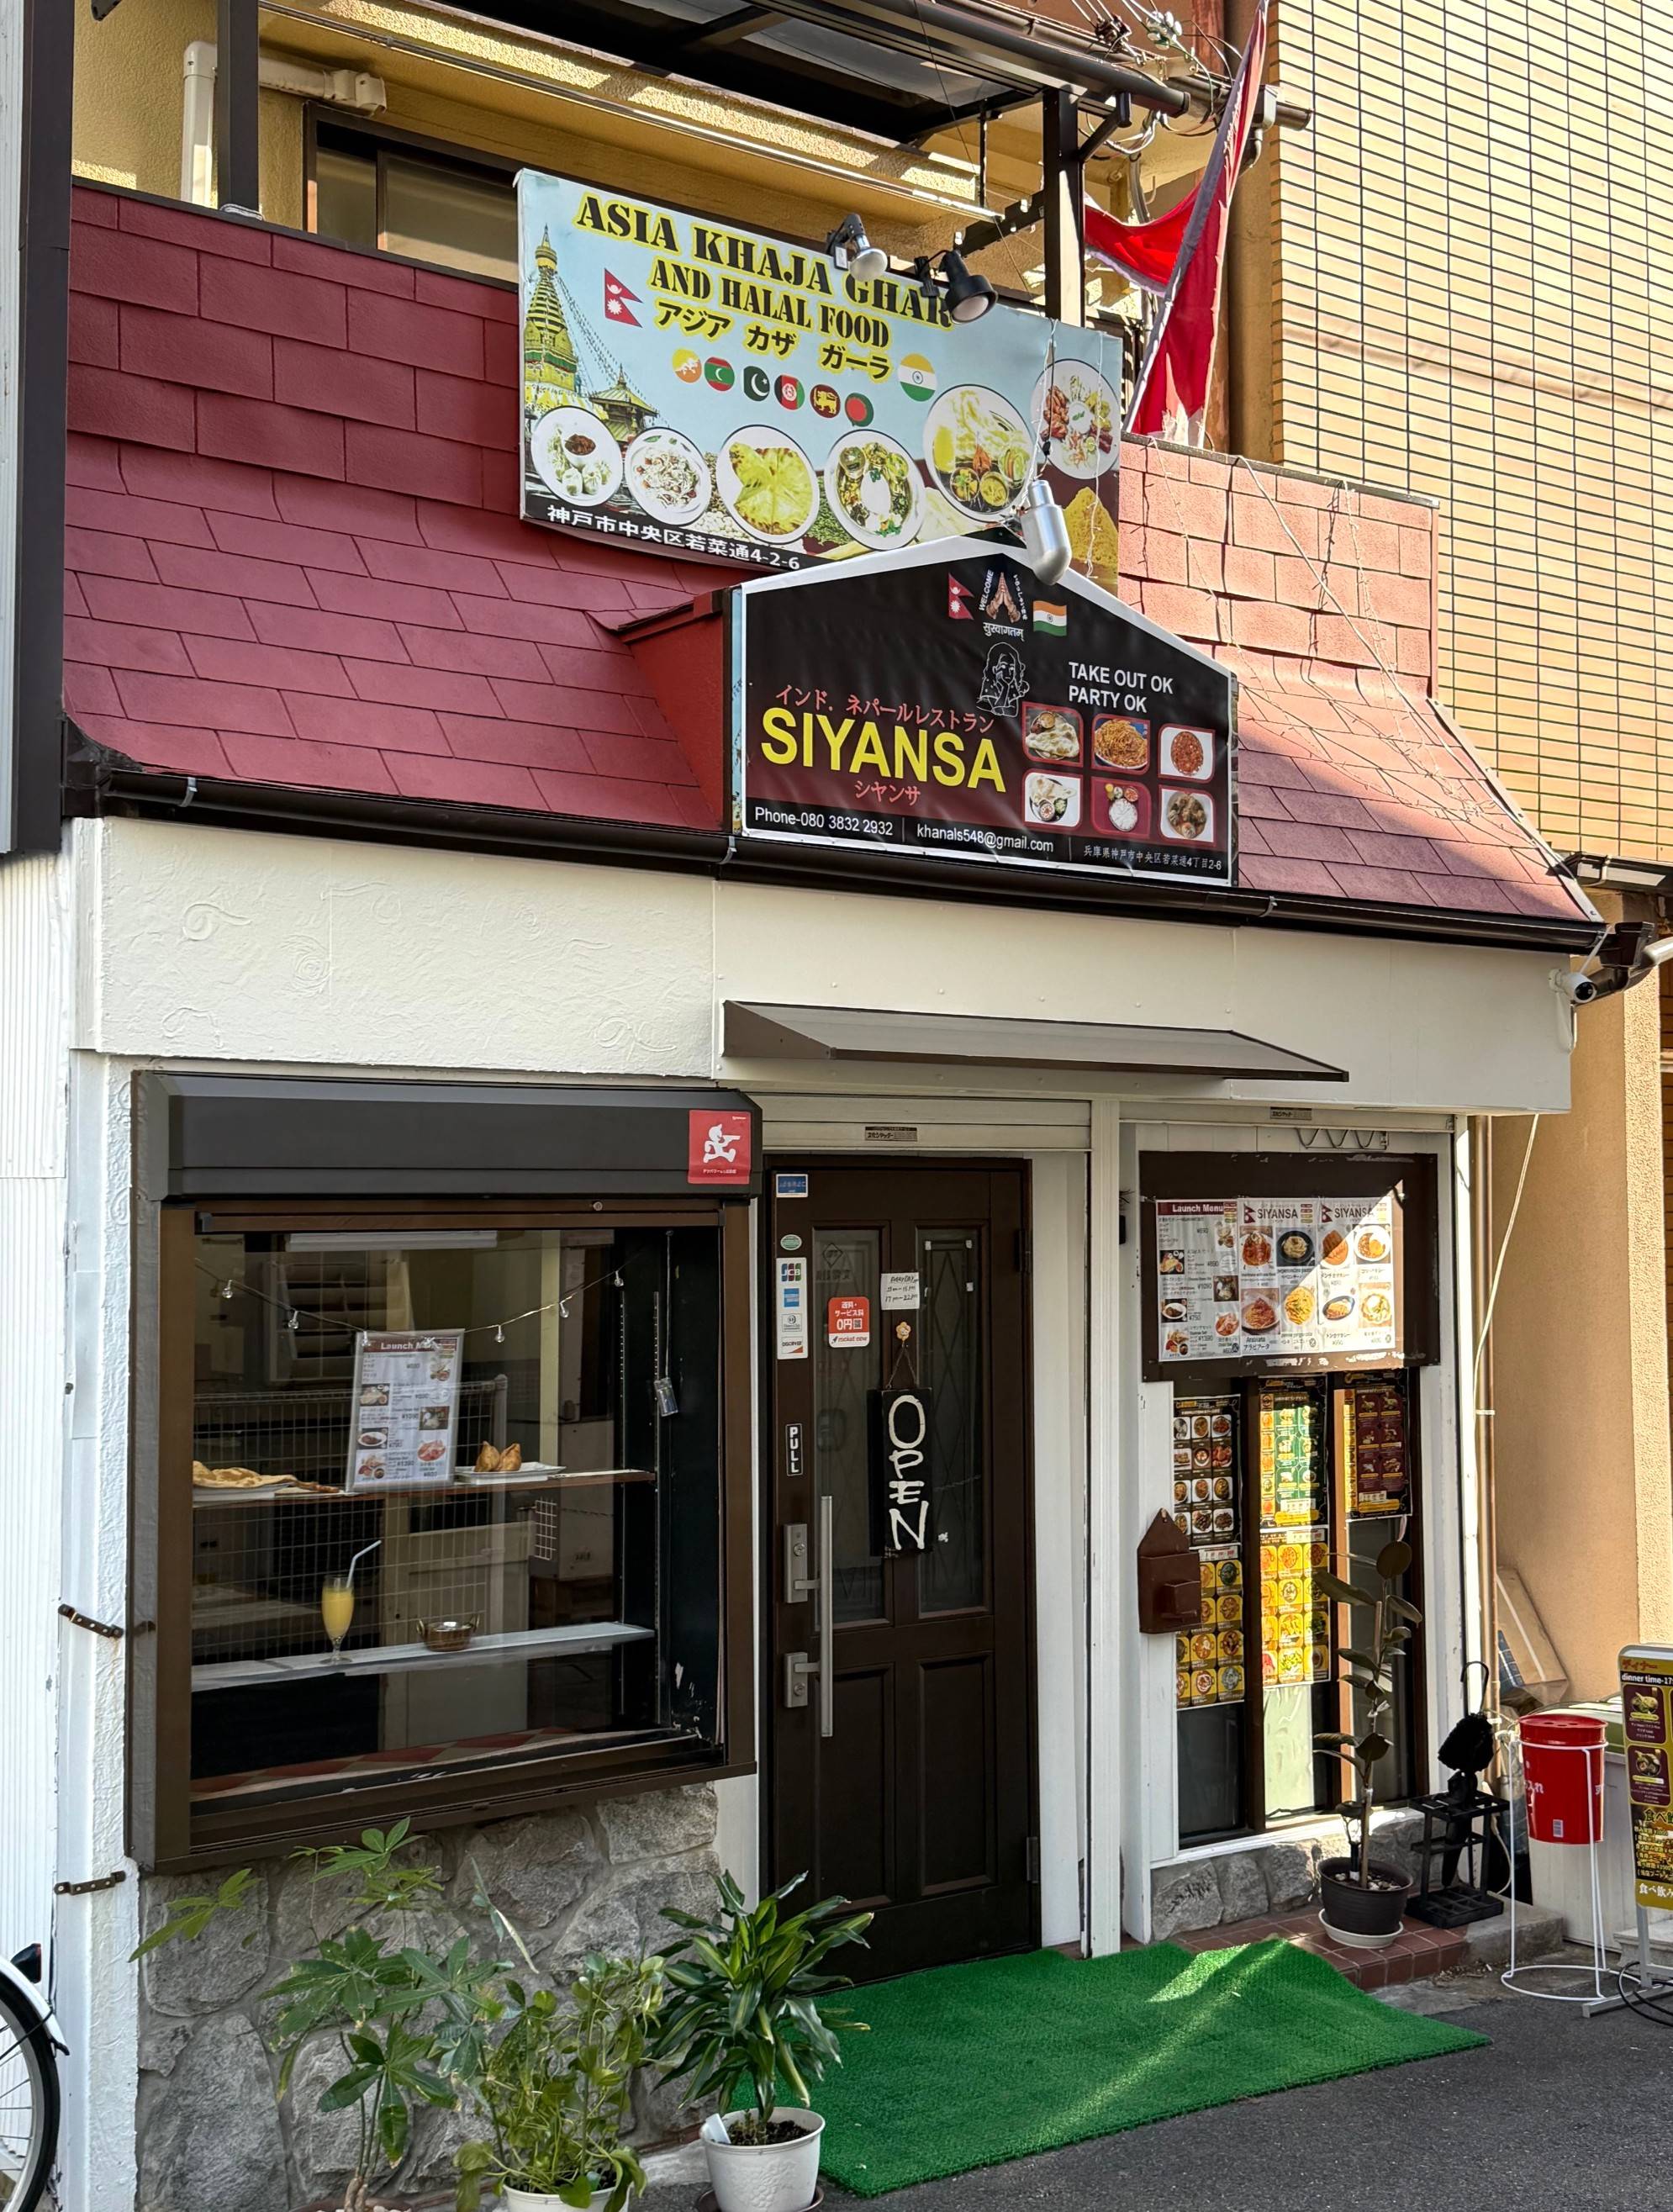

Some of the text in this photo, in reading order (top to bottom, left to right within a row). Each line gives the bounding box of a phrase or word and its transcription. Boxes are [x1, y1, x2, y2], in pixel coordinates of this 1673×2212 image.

[577, 196, 679, 252] ASIA
[694, 226, 833, 295] KHAJA
[651, 259, 889, 348] AND HALAL FOOD
[658, 301, 891, 380] アジア カザ ガーラ
[547, 504, 800, 570] 神戸市中央区若菜通4-2-6
[979, 569, 994, 611] WELCOME
[1069, 662, 1174, 694] TAKE OUT OK
[846, 694, 995, 734] ネパールレストラン
[1069, 685, 1147, 713] PARTY OK
[761, 707, 1006, 793] SIYANSA
[755, 806, 893, 836] Phone-080 3832 2932
[917, 823, 1054, 853] khanals548@gmail.com
[1172, 1204, 1201, 1212] Launch
[1257, 1208, 1298, 1219] SIYANSA
[836, 1318, 852, 1330] 0円
[381, 1342, 414, 1350] Launch
[789, 1426, 800, 1473] PULL
[888, 1394, 929, 1550] OPEN
[1621, 1672, 1644, 1681] dinner
